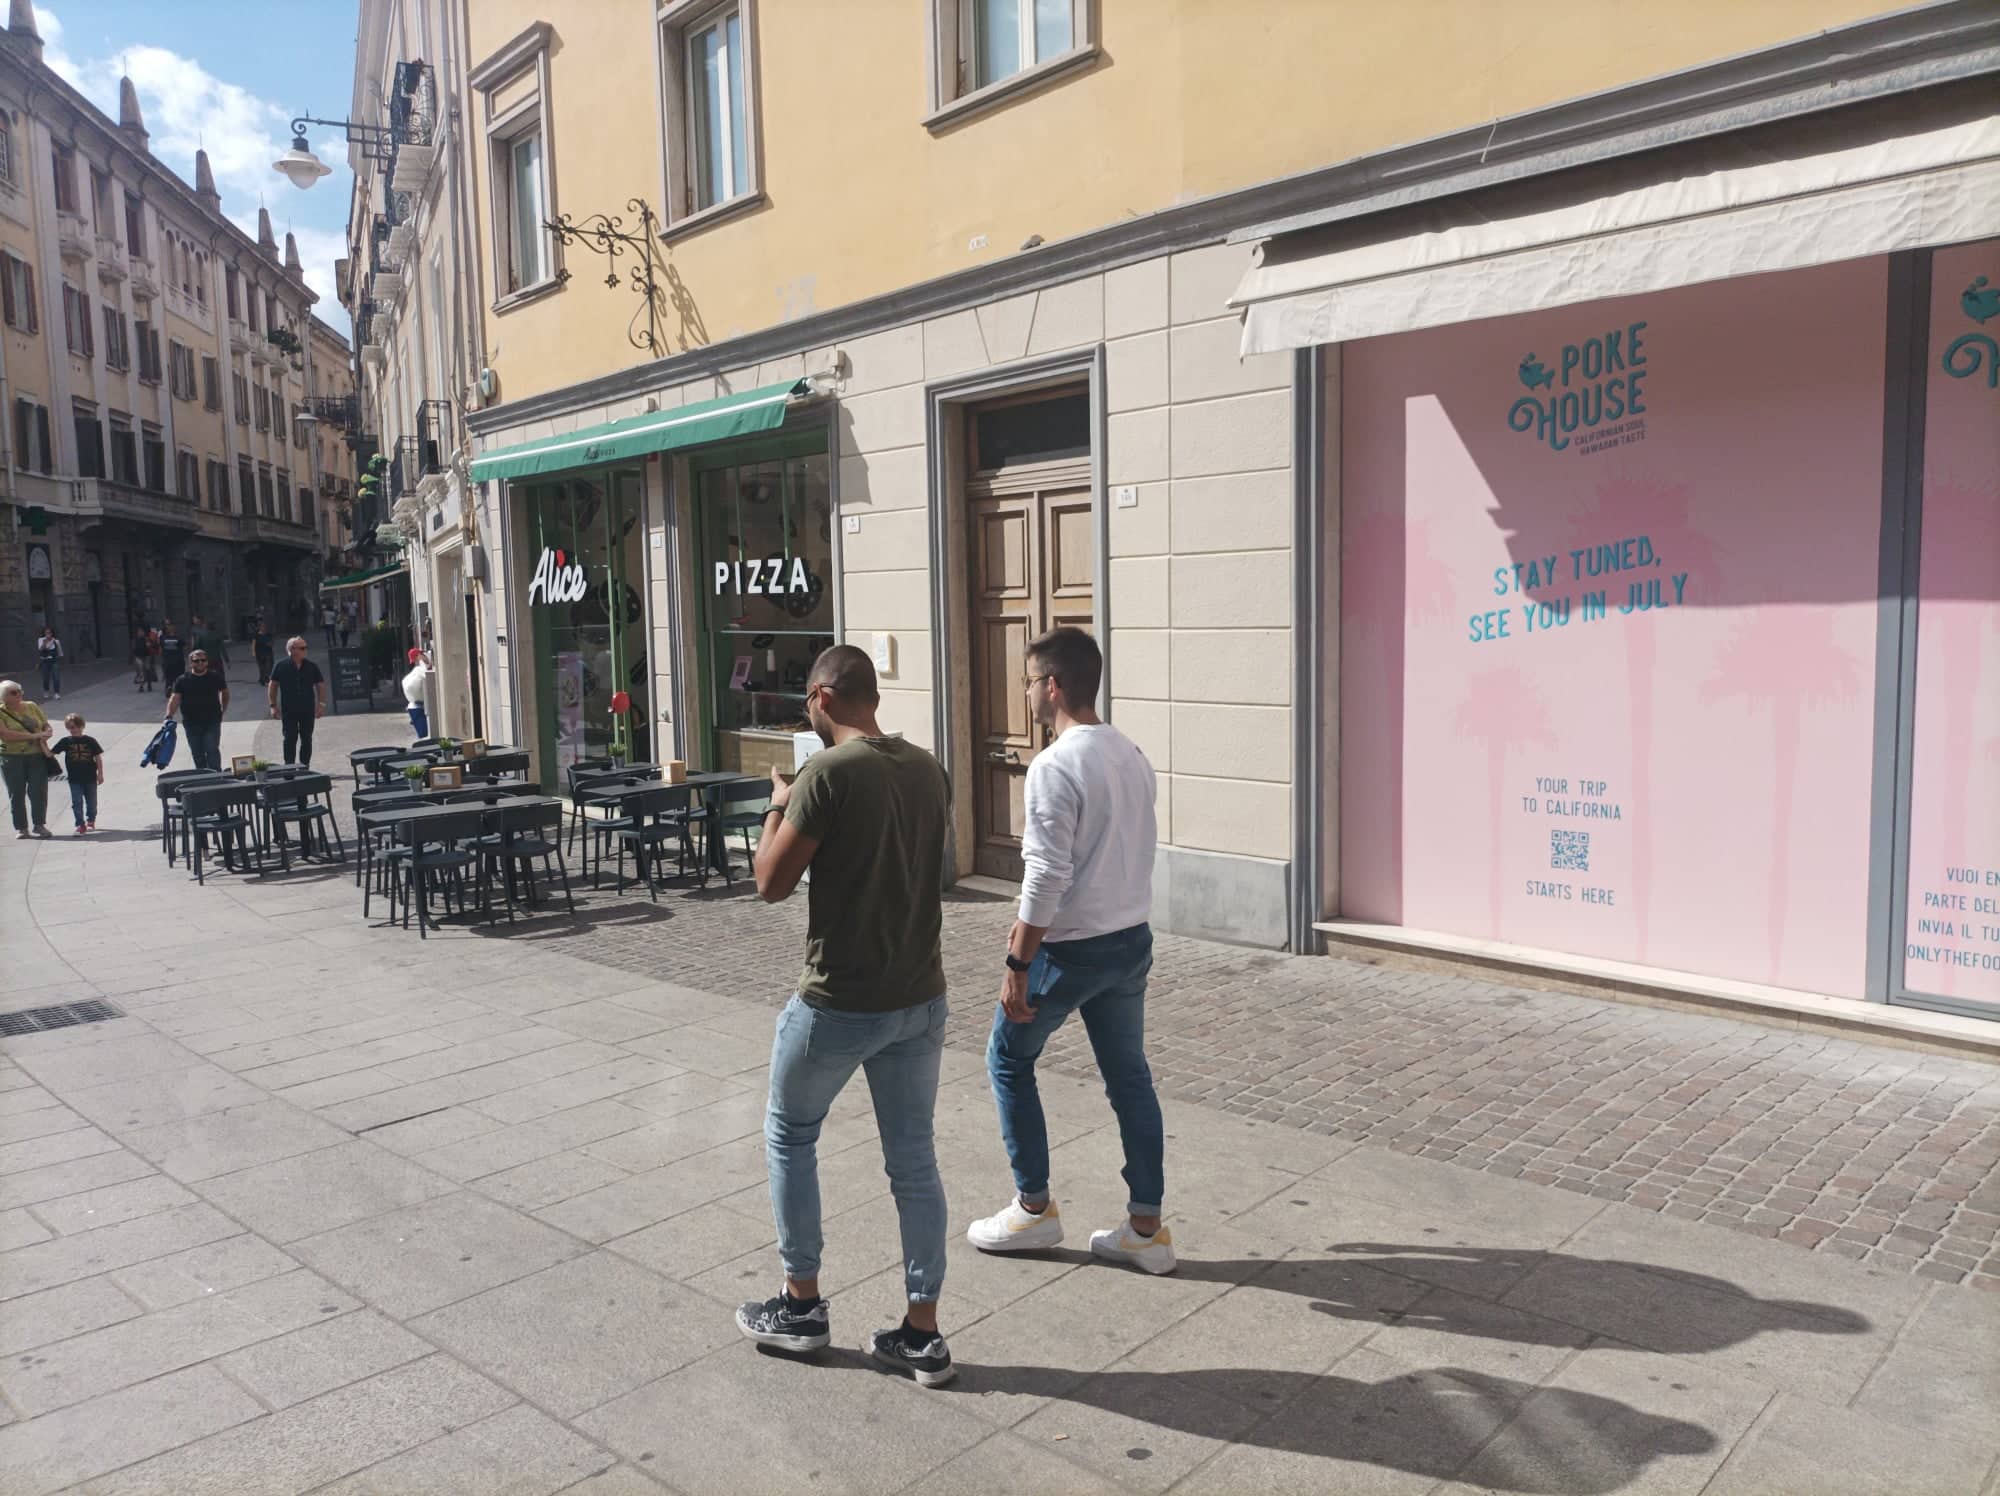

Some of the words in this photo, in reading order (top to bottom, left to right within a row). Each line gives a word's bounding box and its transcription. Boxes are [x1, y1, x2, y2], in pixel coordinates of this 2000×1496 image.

[1561, 320, 1648, 387] POKE
[1507, 369, 1648, 451] HOUSE
[529, 546, 587, 607] Alice
[714, 556, 809, 595] PIZZA
[1493, 555, 1557, 596] STAY
[1569, 535, 1662, 581] TUNED,
[1469, 609, 1511, 643] SEE
[1522, 596, 1570, 633] YOU
[1582, 590, 1606, 623] IN
[1618, 572, 1689, 615] JULY
[1536, 777, 1568, 794] YOUR
[1579, 780, 1607, 797] TRIP
[1522, 797, 1537, 813] TO
[1546, 799, 1622, 820] CALIFORNIA
[1946, 867, 1979, 884] VUOI
[1526, 880, 1572, 900] STARTS
[1581, 887, 1615, 906] HERE
[1924, 892, 1966, 911] PARTE
[1918, 919, 1954, 937] INVIA
[1961, 924, 1973, 939] IL
